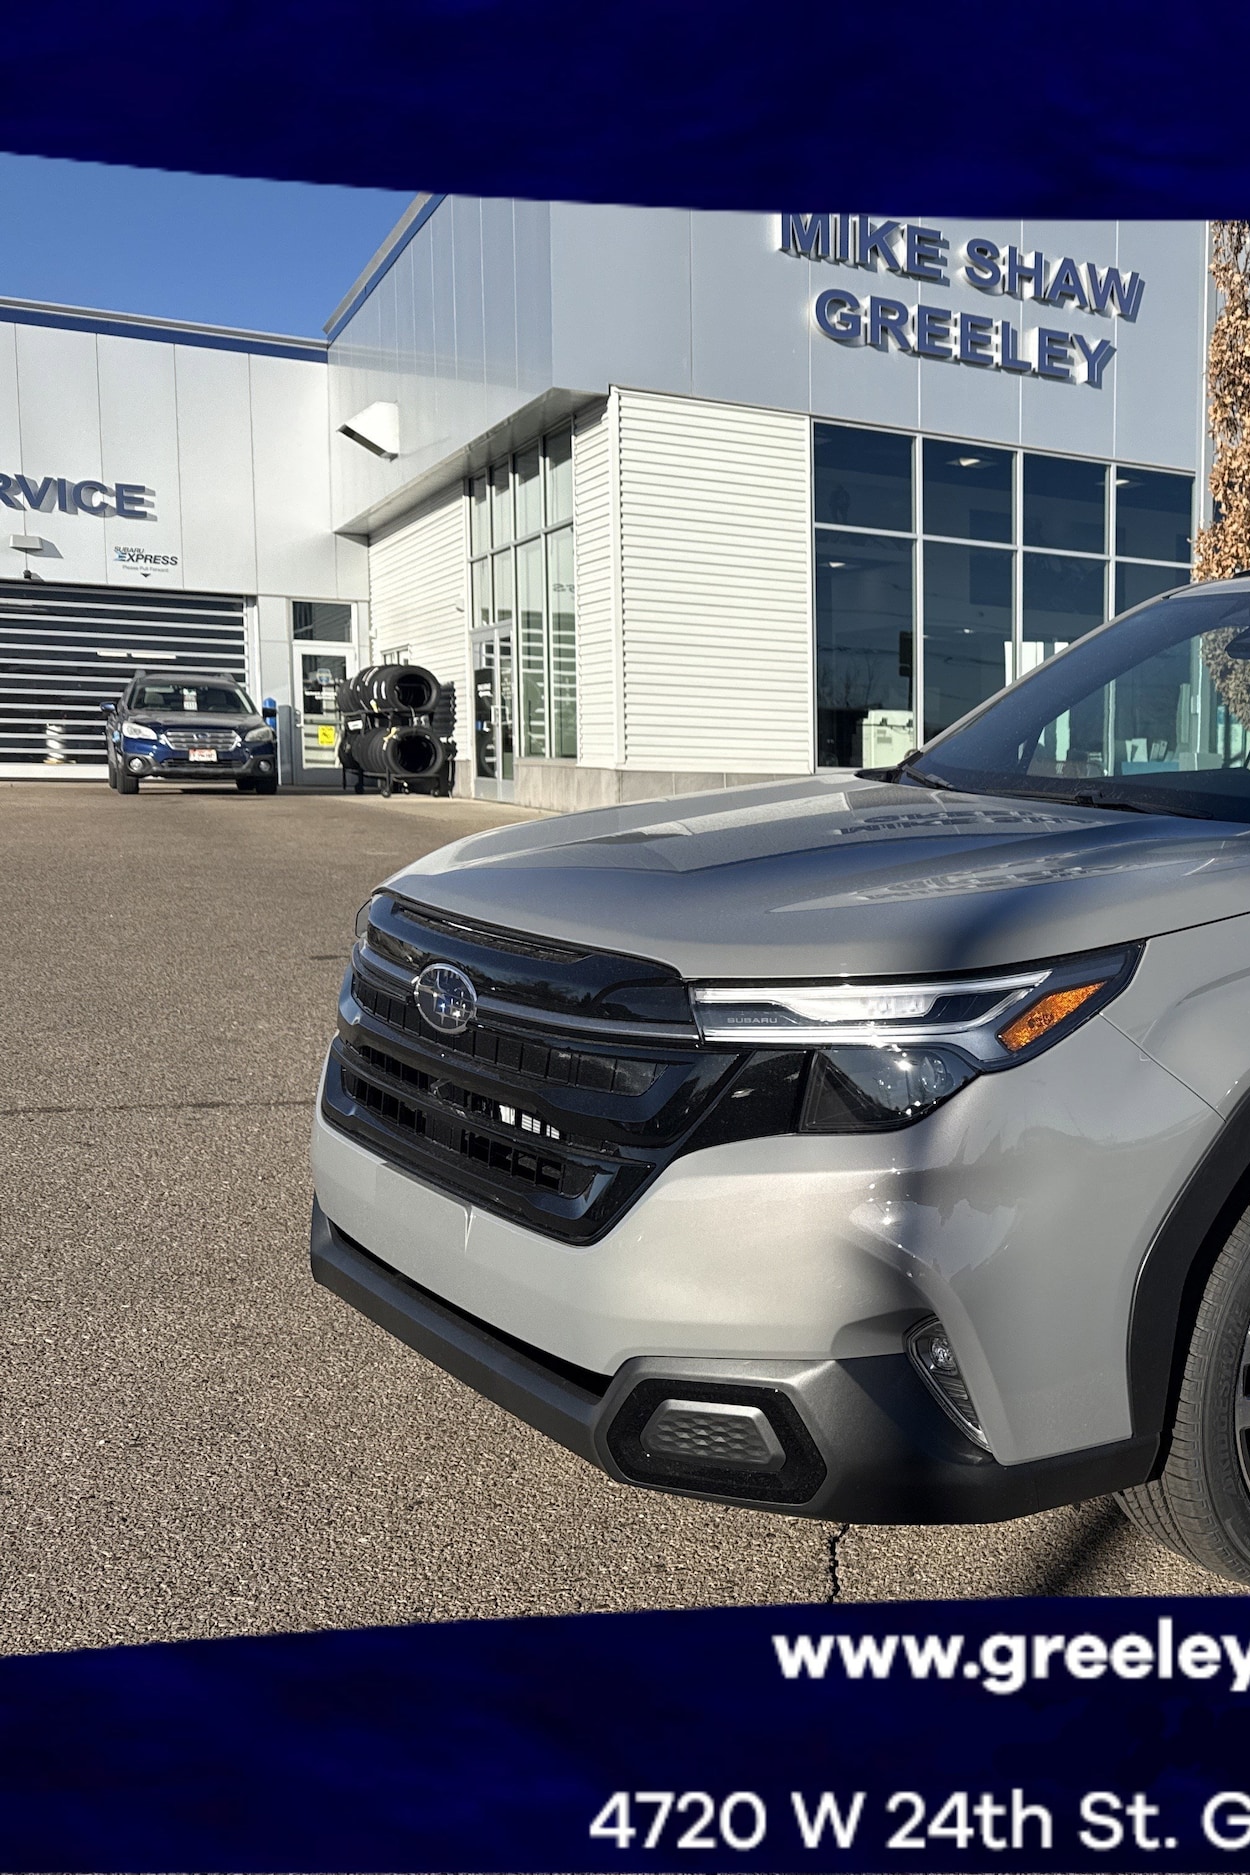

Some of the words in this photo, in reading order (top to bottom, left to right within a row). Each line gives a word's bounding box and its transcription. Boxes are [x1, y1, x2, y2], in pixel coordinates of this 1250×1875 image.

[781, 213, 943, 279] MIKE
[965, 238, 1140, 315] SHAW
[815, 289, 1111, 384] GREELEY
[116, 552, 178, 566] EXPRESS
